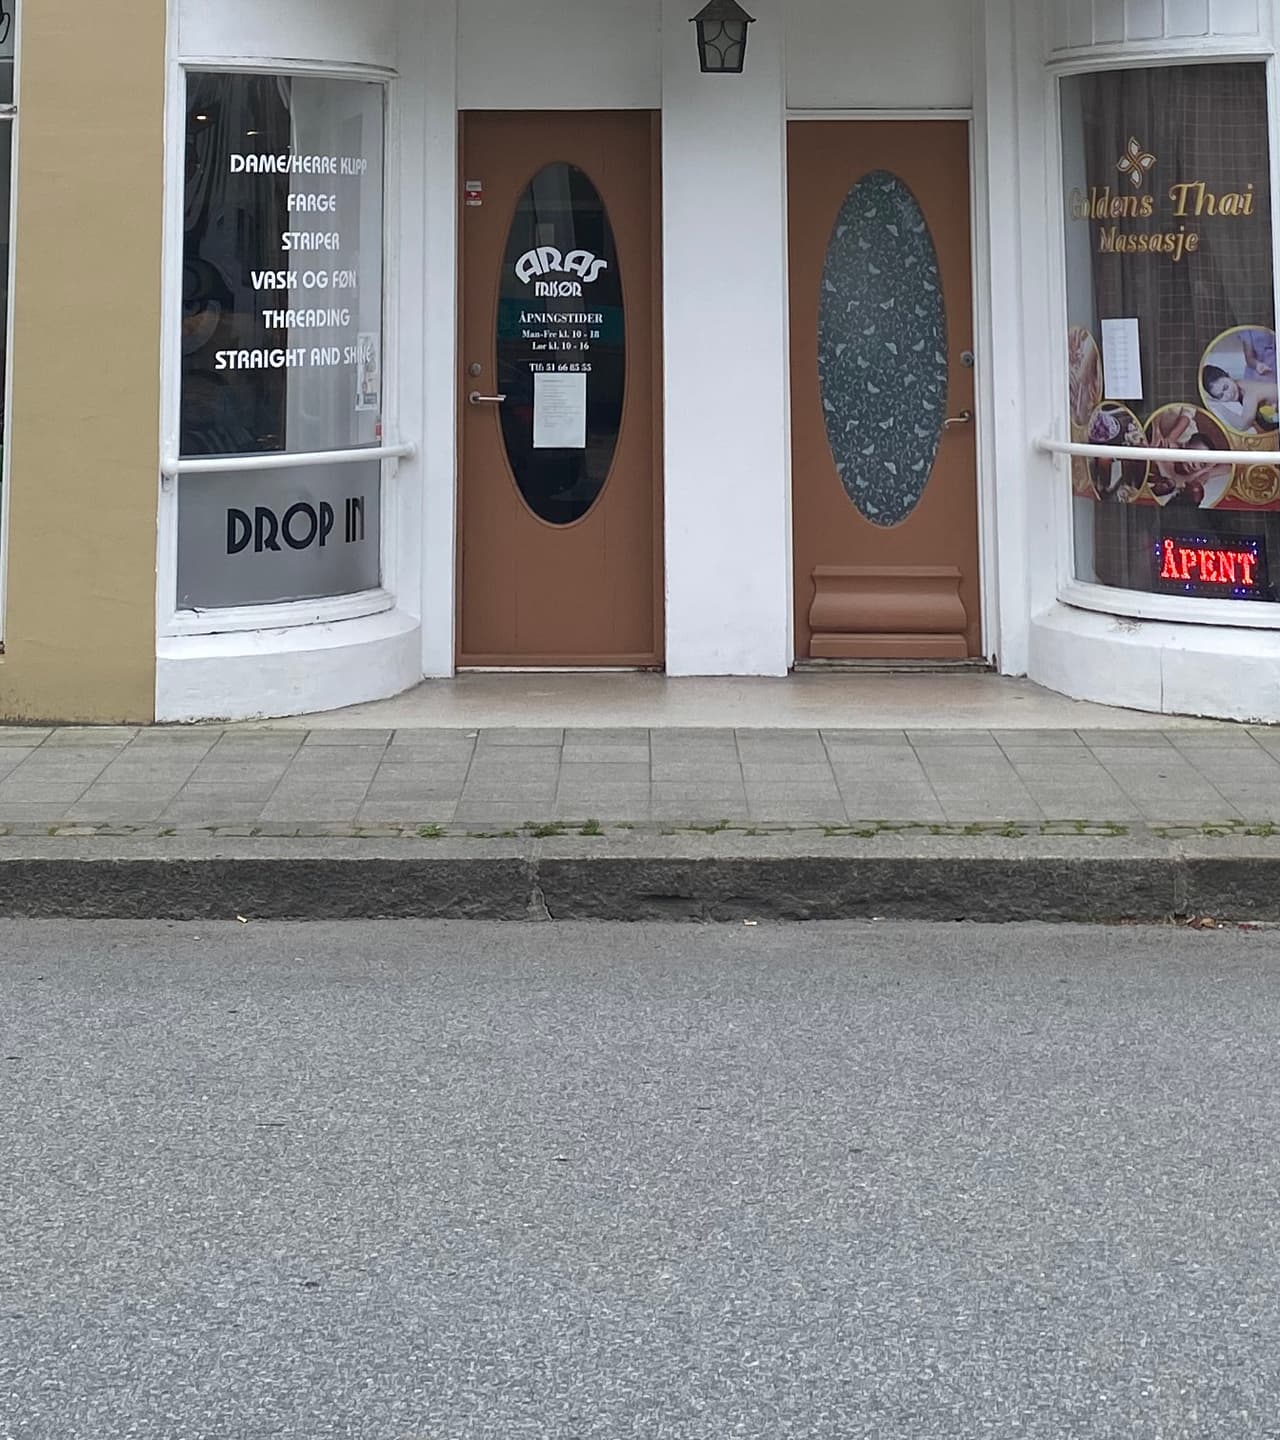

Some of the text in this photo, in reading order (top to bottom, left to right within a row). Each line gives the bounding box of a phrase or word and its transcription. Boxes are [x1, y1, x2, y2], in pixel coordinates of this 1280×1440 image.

[230, 154, 367, 176] DAME/HERRE KLIPP
[287, 193, 336, 212] FARGE
[1071, 180, 1255, 222] Goldens Thai
[281, 232, 340, 251] STRIPER
[1098, 225, 1200, 262] Massasje
[515, 246, 608, 285] ARAS
[251, 270, 357, 290] VASK OG FØN
[535, 281, 583, 298] FRISØR
[263, 309, 351, 329] THREADING
[519, 310, 604, 324] ÅPNINGSTIDER
[572, 330, 582, 338] 10
[562, 341, 572, 350] 10
[580, 341, 590, 350] 16
[215, 345, 371, 370] STRAIGHT AND SHINE
[227, 496, 365, 555] DROP IN
[1160, 539, 1256, 585] ÅPENT
